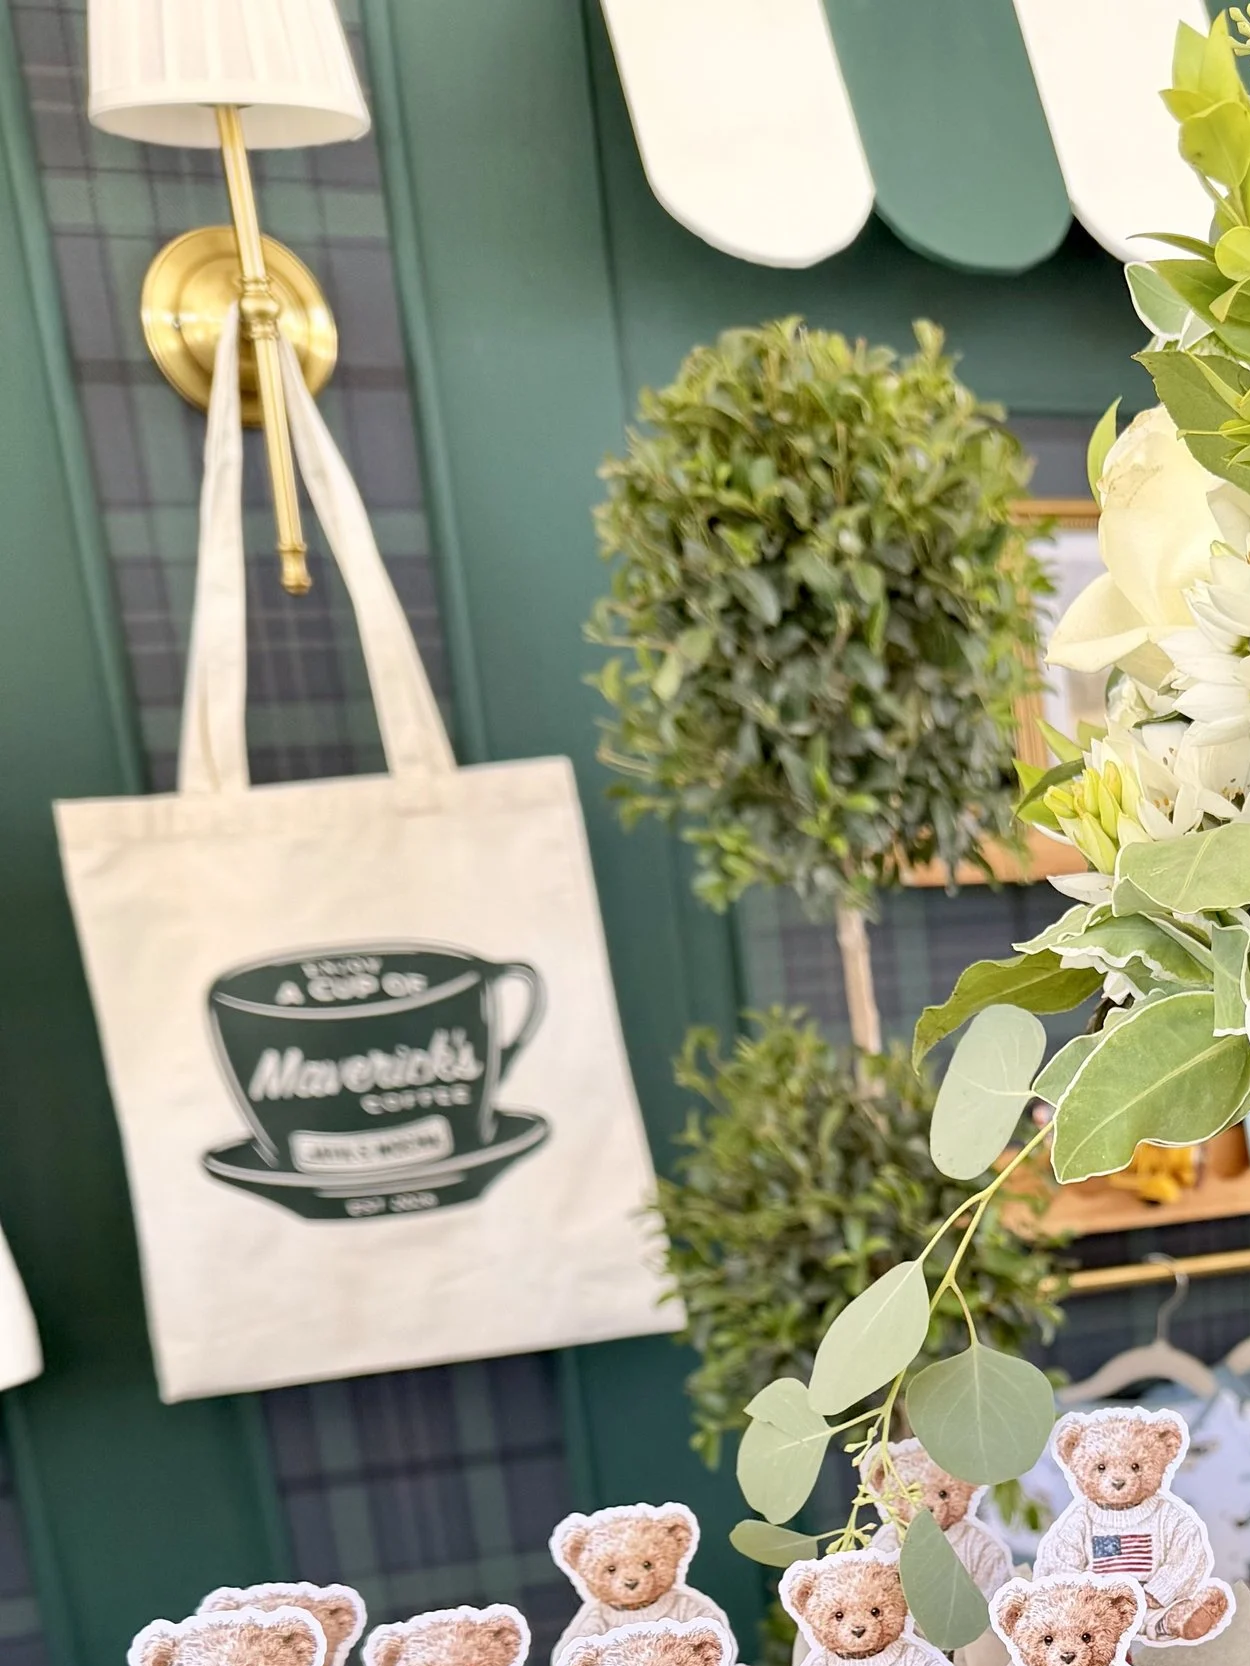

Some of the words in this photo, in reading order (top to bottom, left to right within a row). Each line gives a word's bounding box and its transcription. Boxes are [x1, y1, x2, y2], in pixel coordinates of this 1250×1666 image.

[275, 981, 305, 1005] A
[307, 972, 380, 1001] CUP
[381, 971, 428, 998] OF
[360, 1083, 472, 1115] COFFEE
